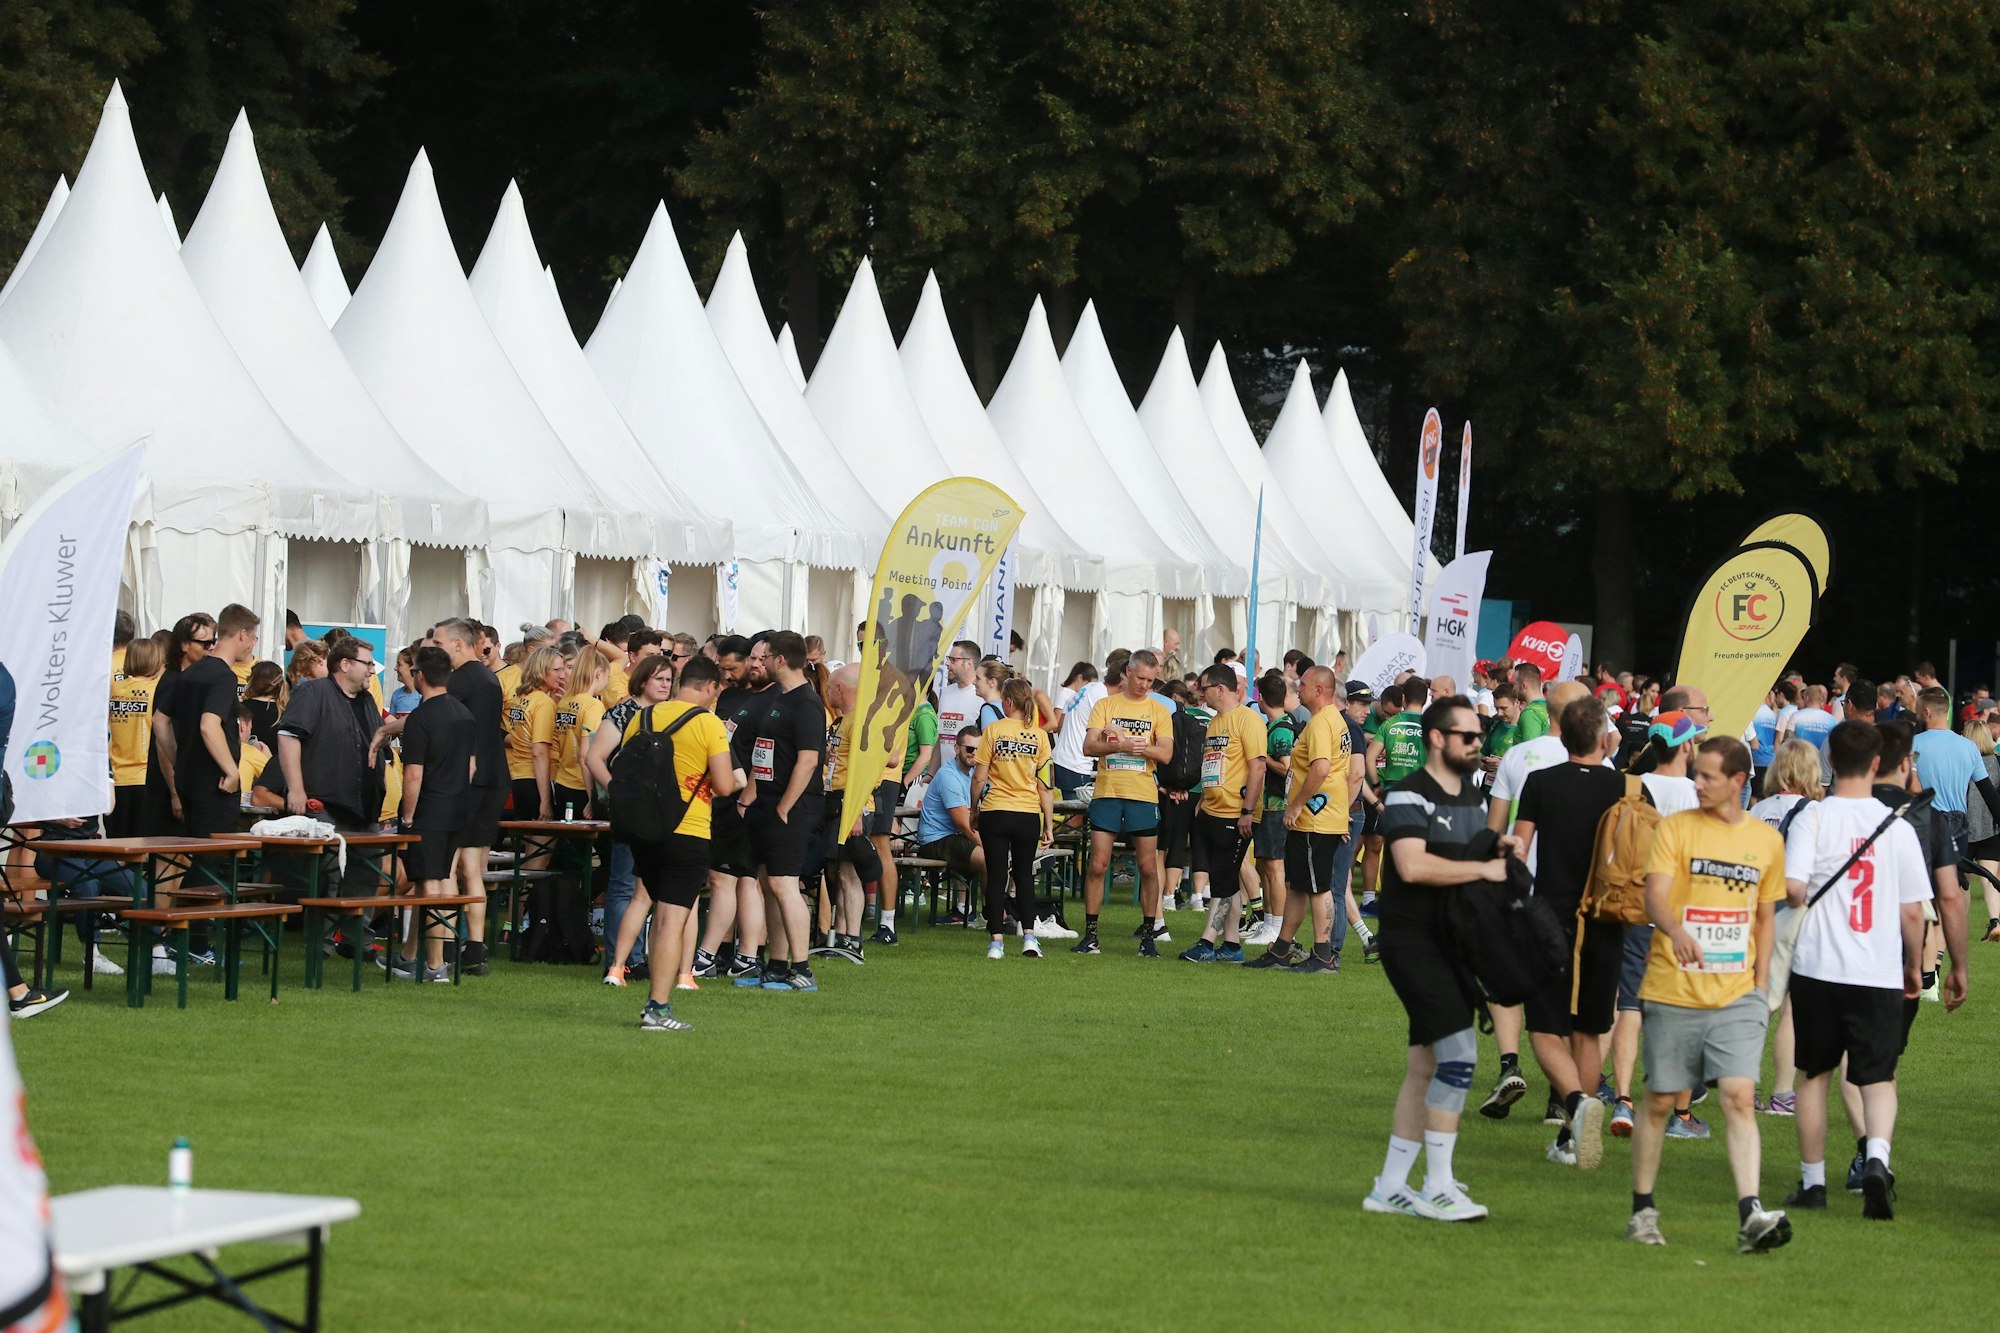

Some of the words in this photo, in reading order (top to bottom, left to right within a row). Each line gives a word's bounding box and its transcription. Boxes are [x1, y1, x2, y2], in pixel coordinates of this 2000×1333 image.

[935, 512, 968, 528] TEAM
[973, 518, 999, 532] CGN
[906, 525, 995, 555] Ankunft
[47, 534, 77, 624] Kluwer
[889, 570, 937, 590] Meeting
[941, 577, 972, 591] Point
[1720, 583, 1729, 591] FC
[1727, 572, 1764, 584] DEUTSCHE
[1765, 576, 1781, 591] POST
[1733, 594, 1768, 621] FC
[1437, 617, 1467, 638] HGK
[1521, 636, 1548, 652] KVB
[1745, 651, 1782, 660] gewinnen.
[36, 631, 67, 731] Wolters
[995, 740, 1037, 754] FLIEGST
[1691, 859, 1760, 884] #TeamCGN
[1848, 860, 1875, 933] 3
[1696, 926, 1742, 941] 11049
